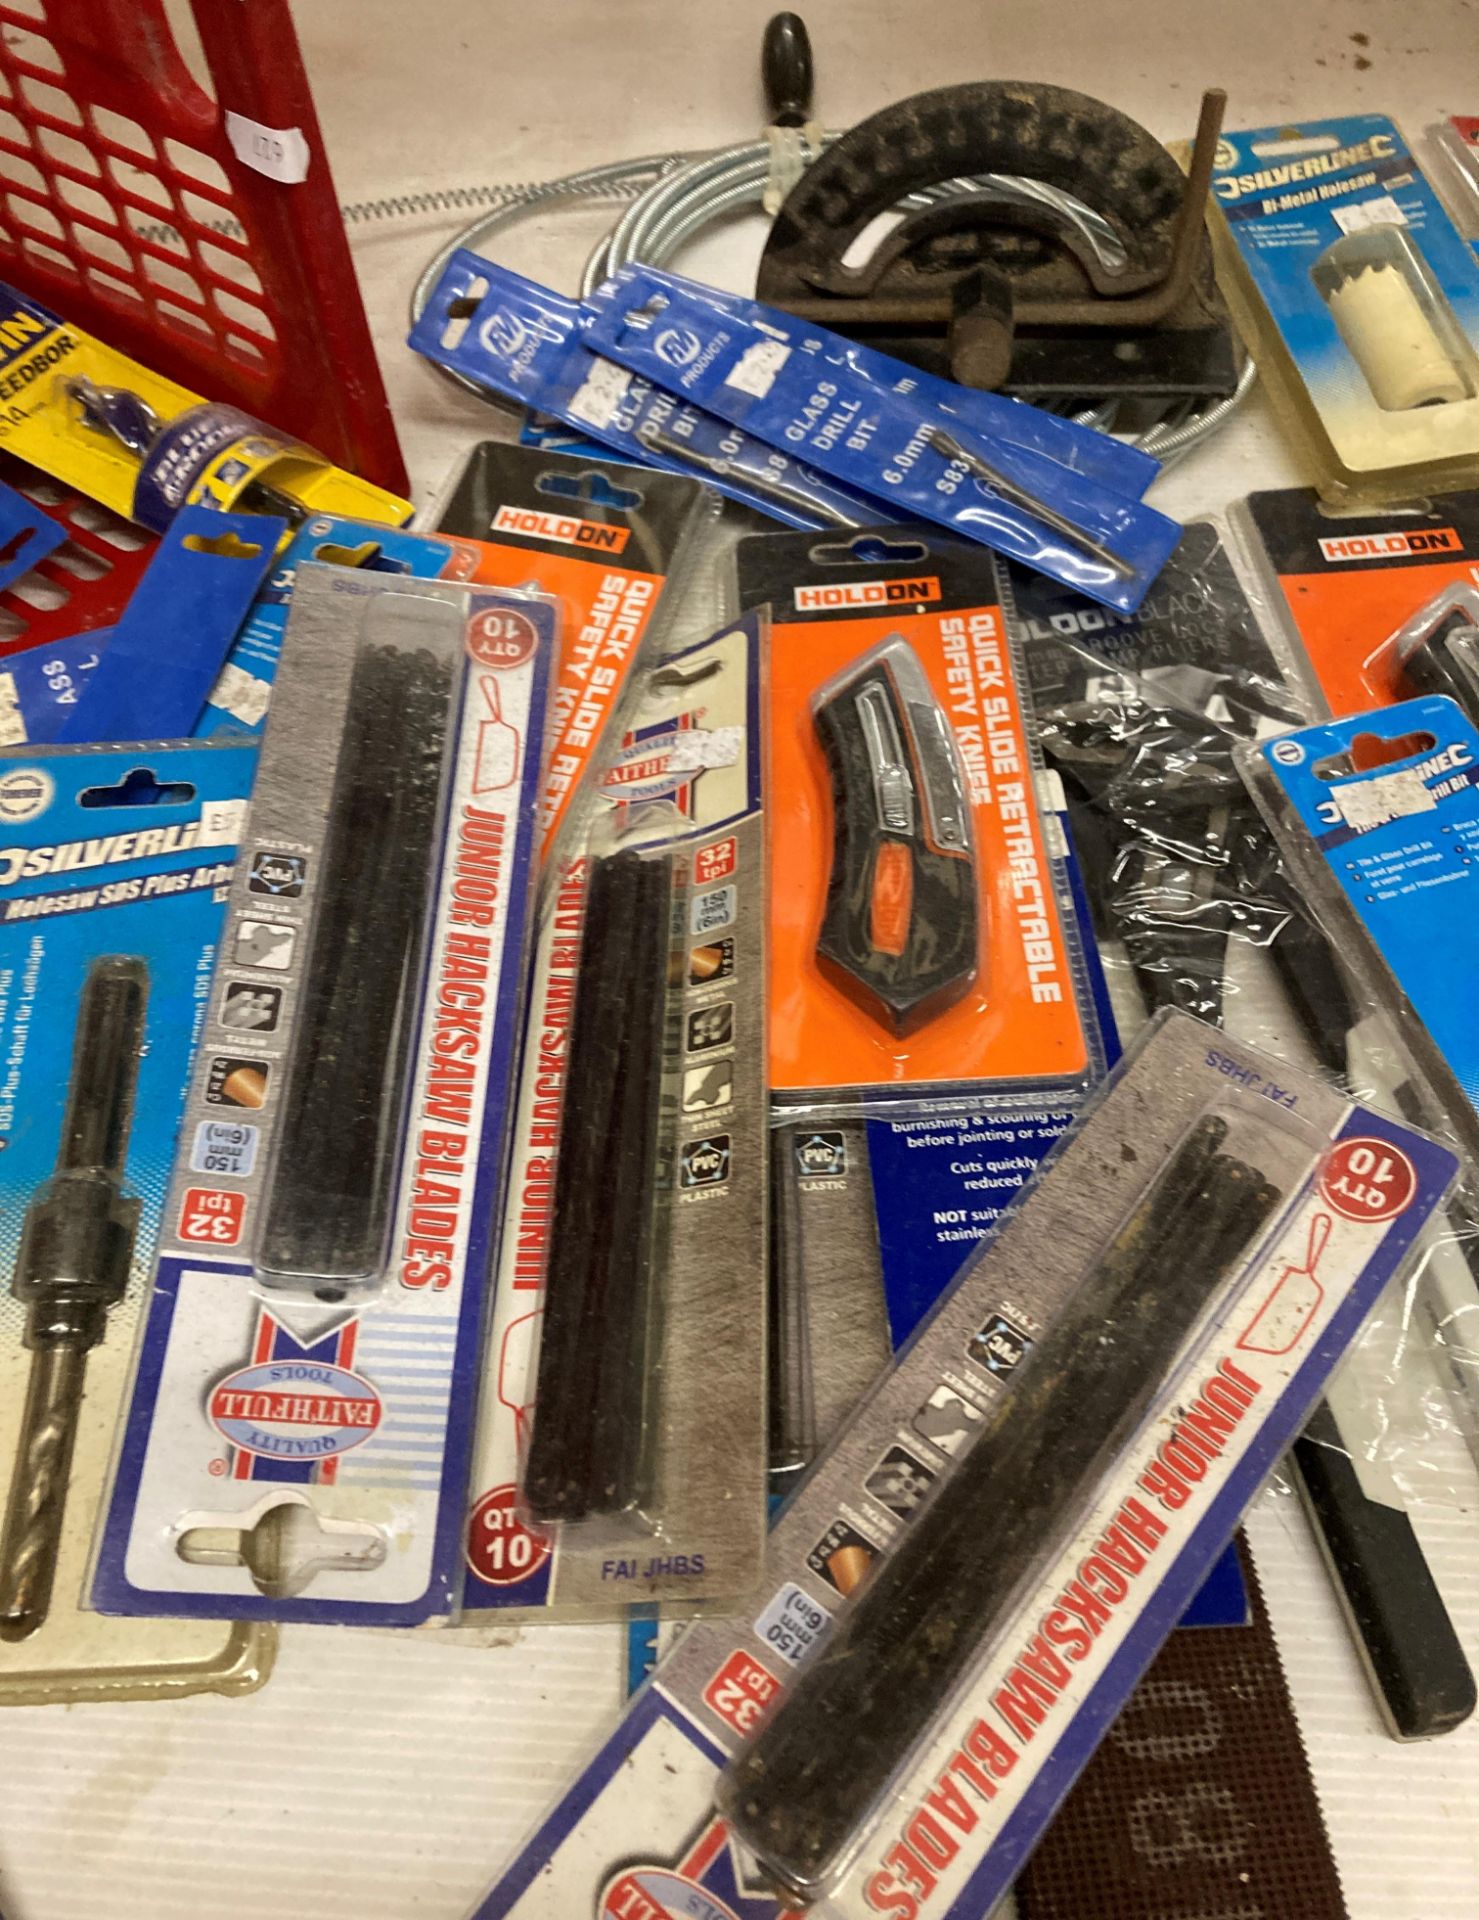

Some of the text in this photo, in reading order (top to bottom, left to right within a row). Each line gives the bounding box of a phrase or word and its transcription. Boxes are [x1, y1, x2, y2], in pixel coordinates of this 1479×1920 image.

[1237, 142, 1371, 194] SILVERLINE
[680, 330, 731, 388] PRODUCTS
[640, 394, 677, 438] DRIL
[784, 381, 838, 441] GLASS
[811, 400, 861, 451] DRILL
[846, 418, 880, 452] BIT
[882, 423, 936, 484] 6.0mm
[498, 509, 619, 547] HOLDON
[1325, 534, 1451, 558] HOLDON
[800, 581, 930, 607] HOLDON
[483, 615, 518, 638] 10
[567, 574, 628, 680] SAFETY
[601, 579, 654, 660] QUICK
[478, 642, 521, 659] QTY
[939, 617, 978, 717] SAFETY
[565, 666, 618, 748] SLIDE
[969, 613, 1064, 1005] QUICK SLIDE RETRACTABLE
[20, 820, 203, 878] SILVERLI
[699, 843, 732, 868] 32
[142, 872, 191, 896] Plus
[703, 861, 728, 880] tpi
[399, 804, 508, 1291] JUNIOR HACKSAW BLADES
[1204, 1048, 1299, 1109] FAI JHBS
[206, 1125, 251, 1145] (6in)
[906, 1123, 1068, 1148] before jointing or sold
[971, 1114, 985, 1126] &
[205, 1154, 242, 1173] 150
[206, 1143, 244, 1156] mm
[950, 1156, 1040, 1175] Cuts quickly
[1347, 1146, 1394, 1185] 10
[798, 1180, 848, 1191] LASTIC
[963, 1173, 1024, 1191] reduced
[1330, 1178, 1387, 1210] QTY
[197, 1193, 233, 1215] tpi
[933, 1209, 968, 1225] NOT
[187, 1215, 236, 1239] 32
[988, 1334, 1024, 1365] PVC
[271, 1365, 333, 1383] TOOLS
[220, 1391, 374, 1427] FAITHFULL
[245, 1430, 337, 1455] QUALITY
[483, 1506, 517, 1529] QT
[486, 1533, 532, 1570] 10
[602, 1554, 706, 1581] FAI JHBS
[765, 1624, 803, 1662] 150
[778, 1612, 815, 1648] mm
[863, 1356, 1263, 1920] JUNIOR HACKSAW BLADES
[737, 1664, 777, 1701] tpi
[713, 1678, 764, 1732] 32
